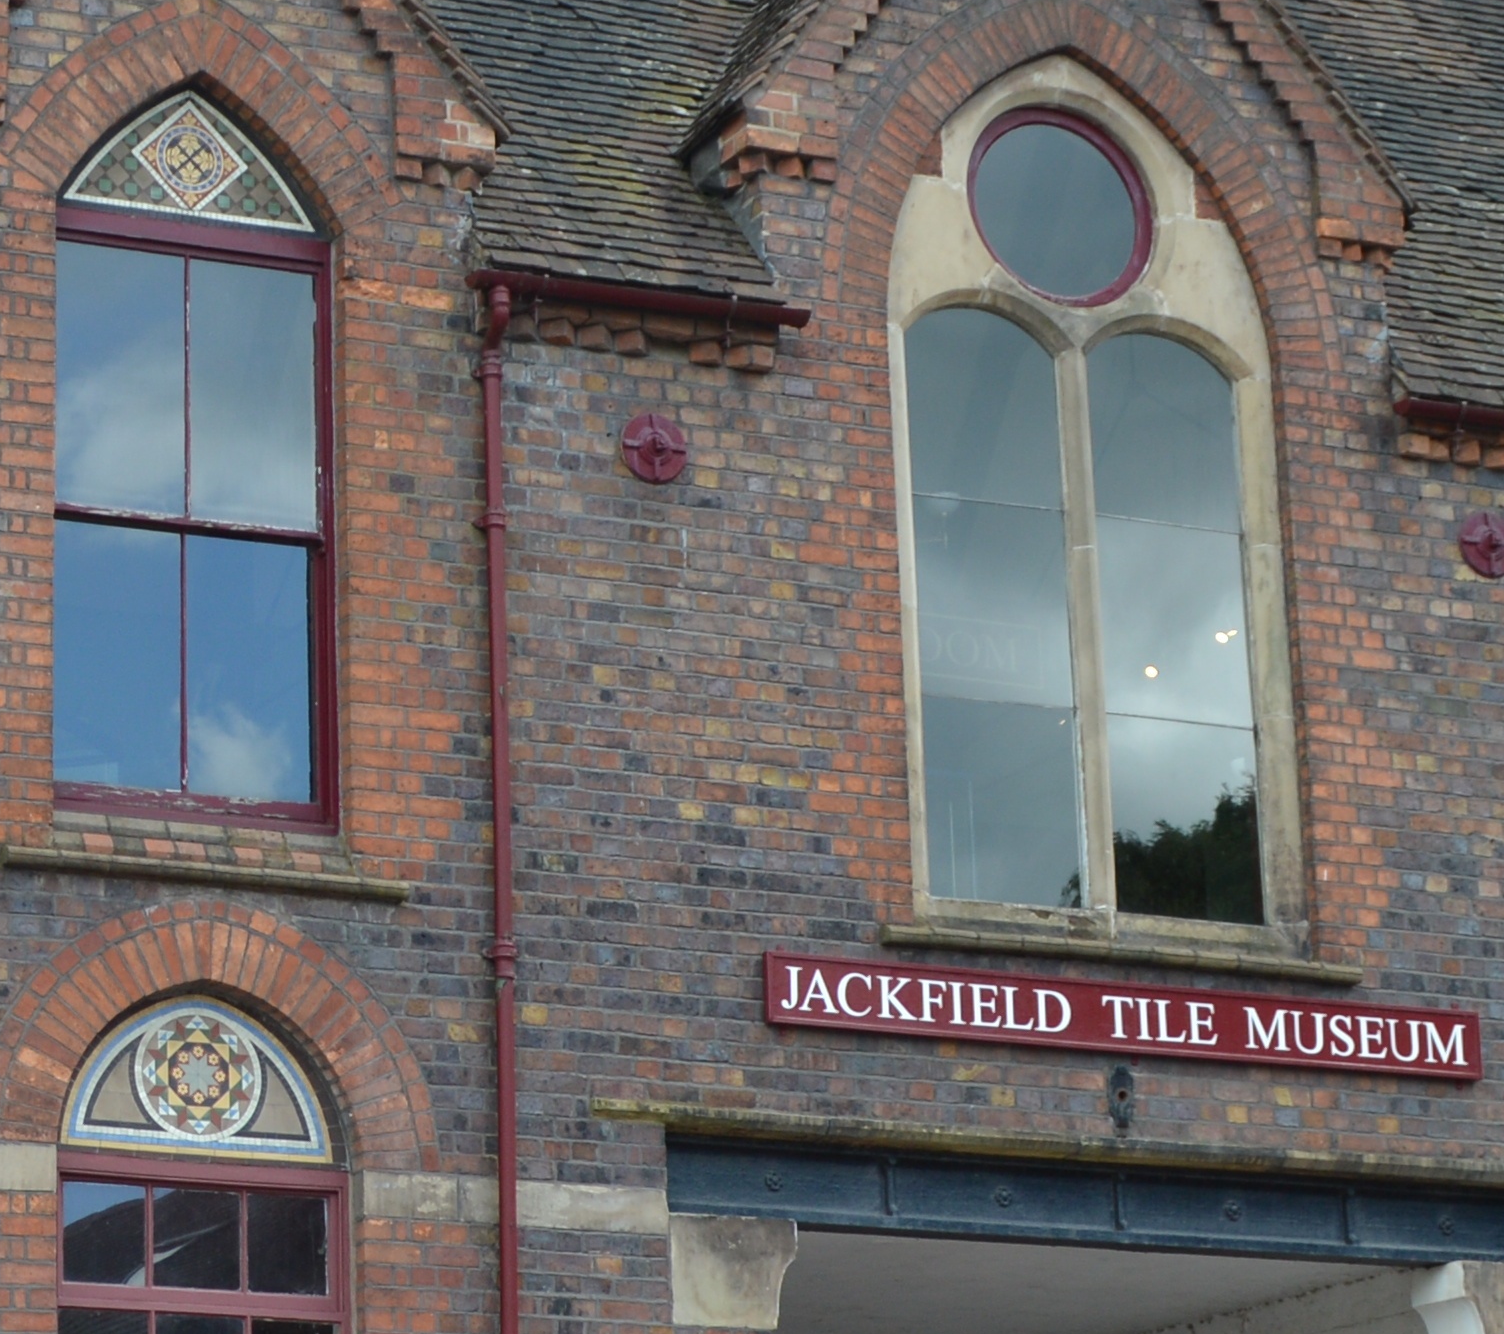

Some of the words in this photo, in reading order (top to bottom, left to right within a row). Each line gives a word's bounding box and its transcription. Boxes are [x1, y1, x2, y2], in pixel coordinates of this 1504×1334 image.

[781, 965, 1073, 1035] JACKFIELD
[1102, 994, 1218, 1046] TILE
[1244, 1006, 1469, 1066] MUSEUM
